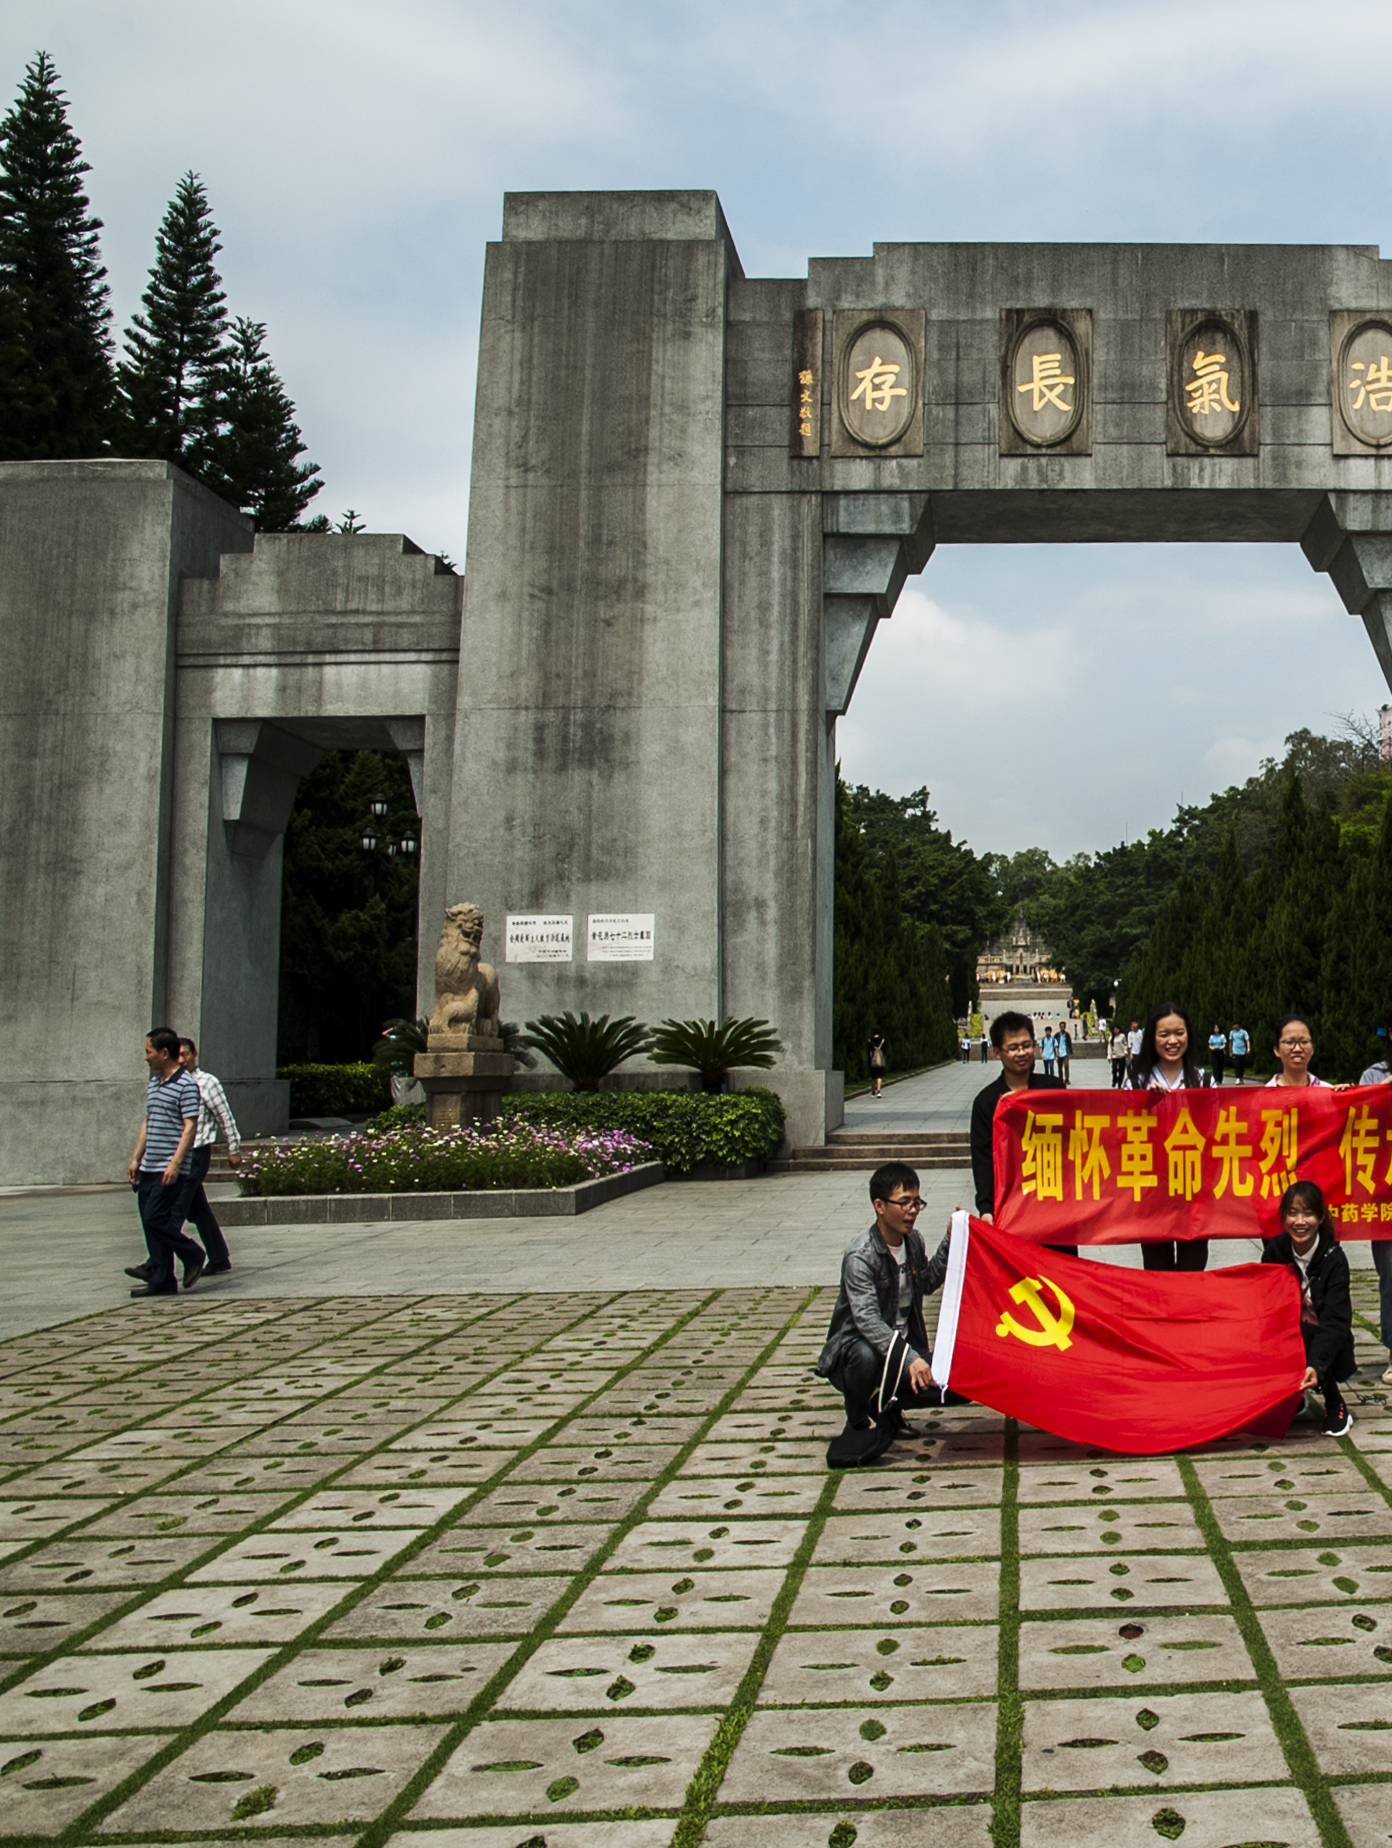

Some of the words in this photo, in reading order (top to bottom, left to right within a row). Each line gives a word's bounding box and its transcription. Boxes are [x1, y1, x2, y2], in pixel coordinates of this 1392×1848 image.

[1020, 1105, 1299, 1202] 缅怀革命先烈
